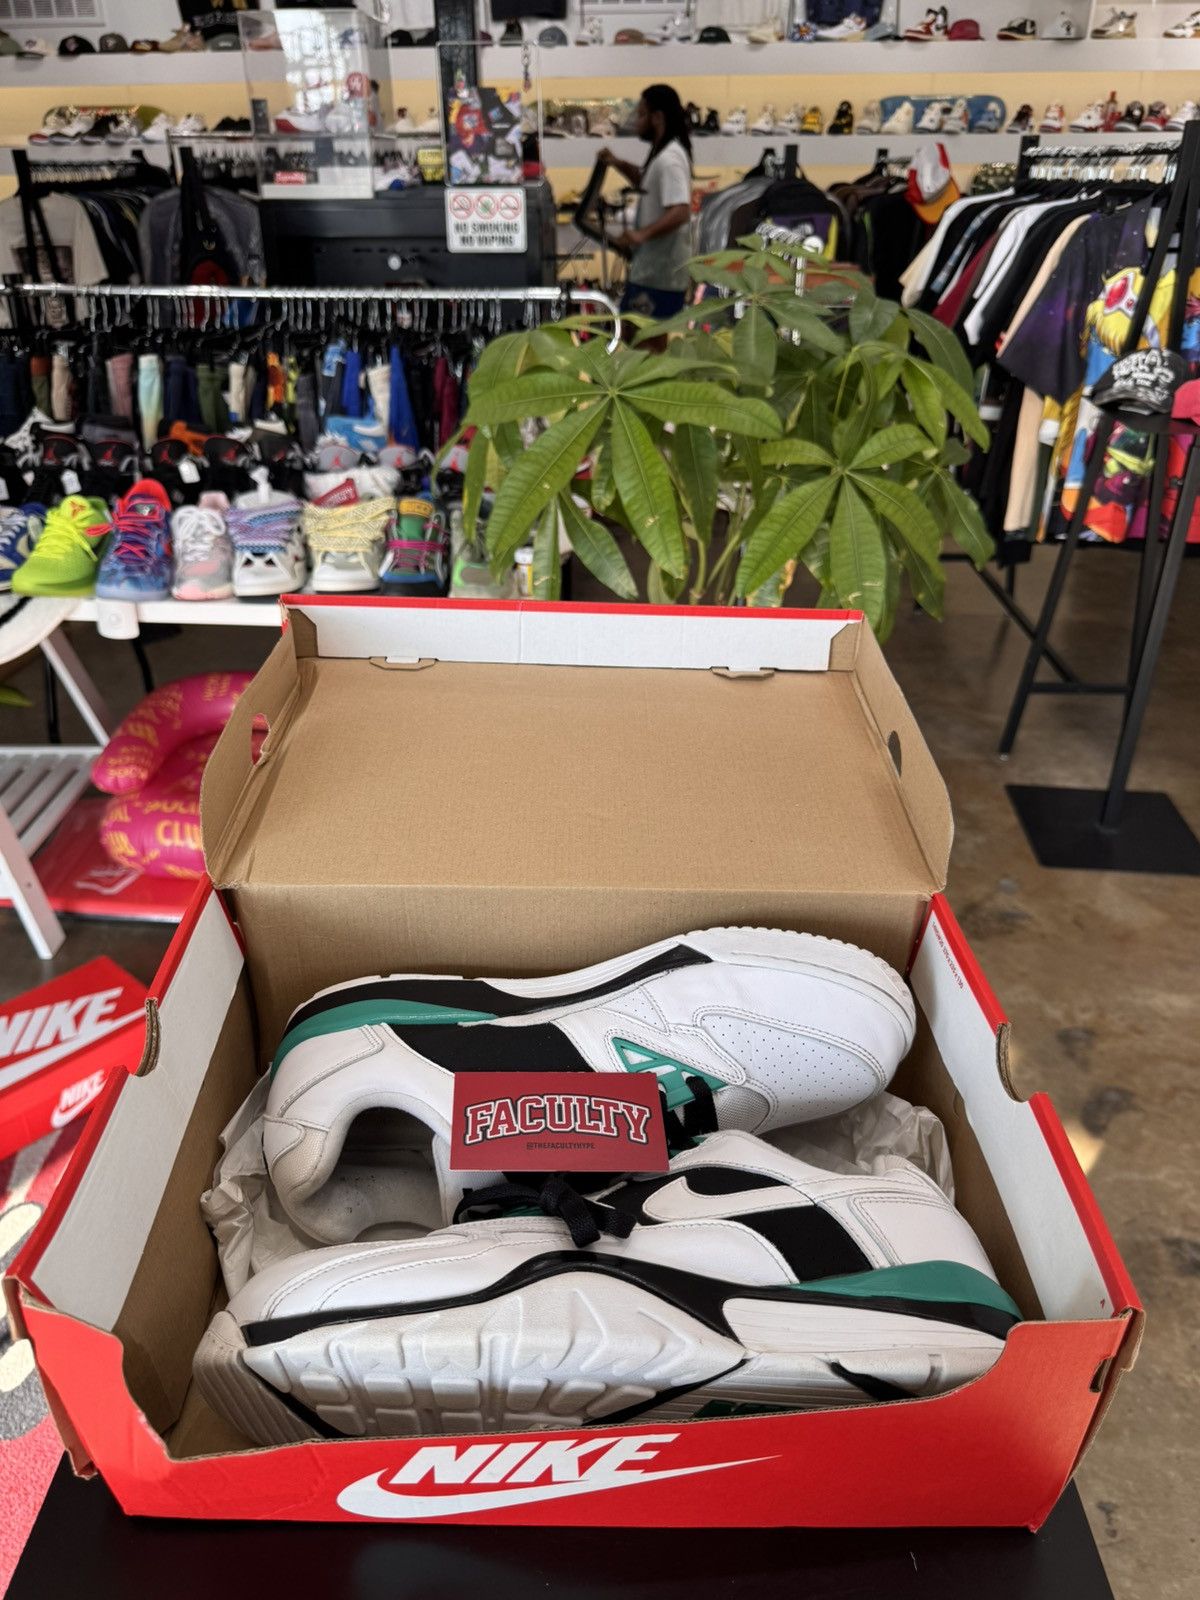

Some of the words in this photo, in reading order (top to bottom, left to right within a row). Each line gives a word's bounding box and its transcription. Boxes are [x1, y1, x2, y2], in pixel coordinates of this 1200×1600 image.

[454, 222, 468, 234] NO
[472, 222, 519, 234] SMOKING
[461, 235, 474, 247] NO
[59, 1068, 106, 1110] NIKE
[465, 1094, 650, 1146] FACULTY
[526, 1141, 595, 1150] @THEFACULTYHYPE
[389, 1432, 681, 1484] NIKE
